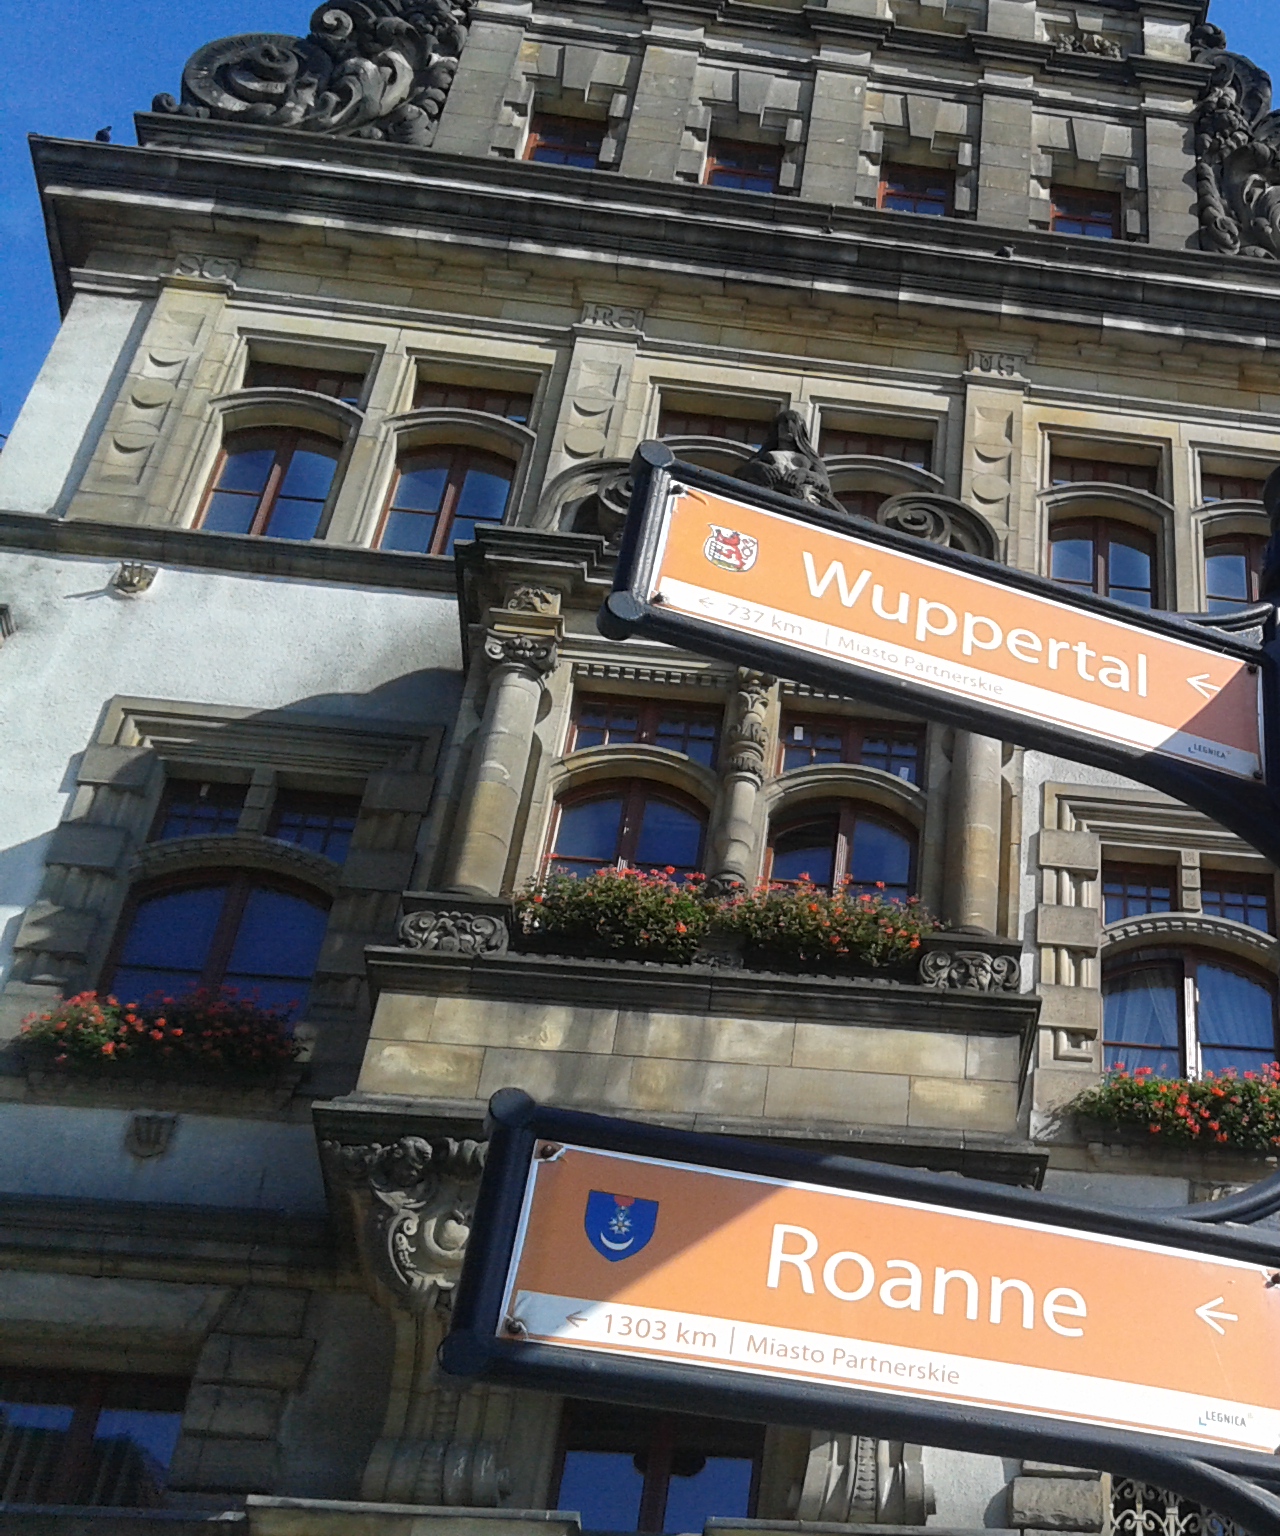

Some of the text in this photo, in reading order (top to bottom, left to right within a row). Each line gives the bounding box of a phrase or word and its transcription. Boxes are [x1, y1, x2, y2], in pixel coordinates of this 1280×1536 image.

[727, 601, 1004, 696] 737 km Miasto Partnerskie
[801, 550, 1148, 698] Wuppertal
[1193, 743, 1226, 760] LEGNICA
[764, 1221, 1089, 1338] Roanne
[604, 1313, 961, 1386] 1303 km Miasto Partnerskie
[1205, 1410, 1247, 1428] LEGNICA
